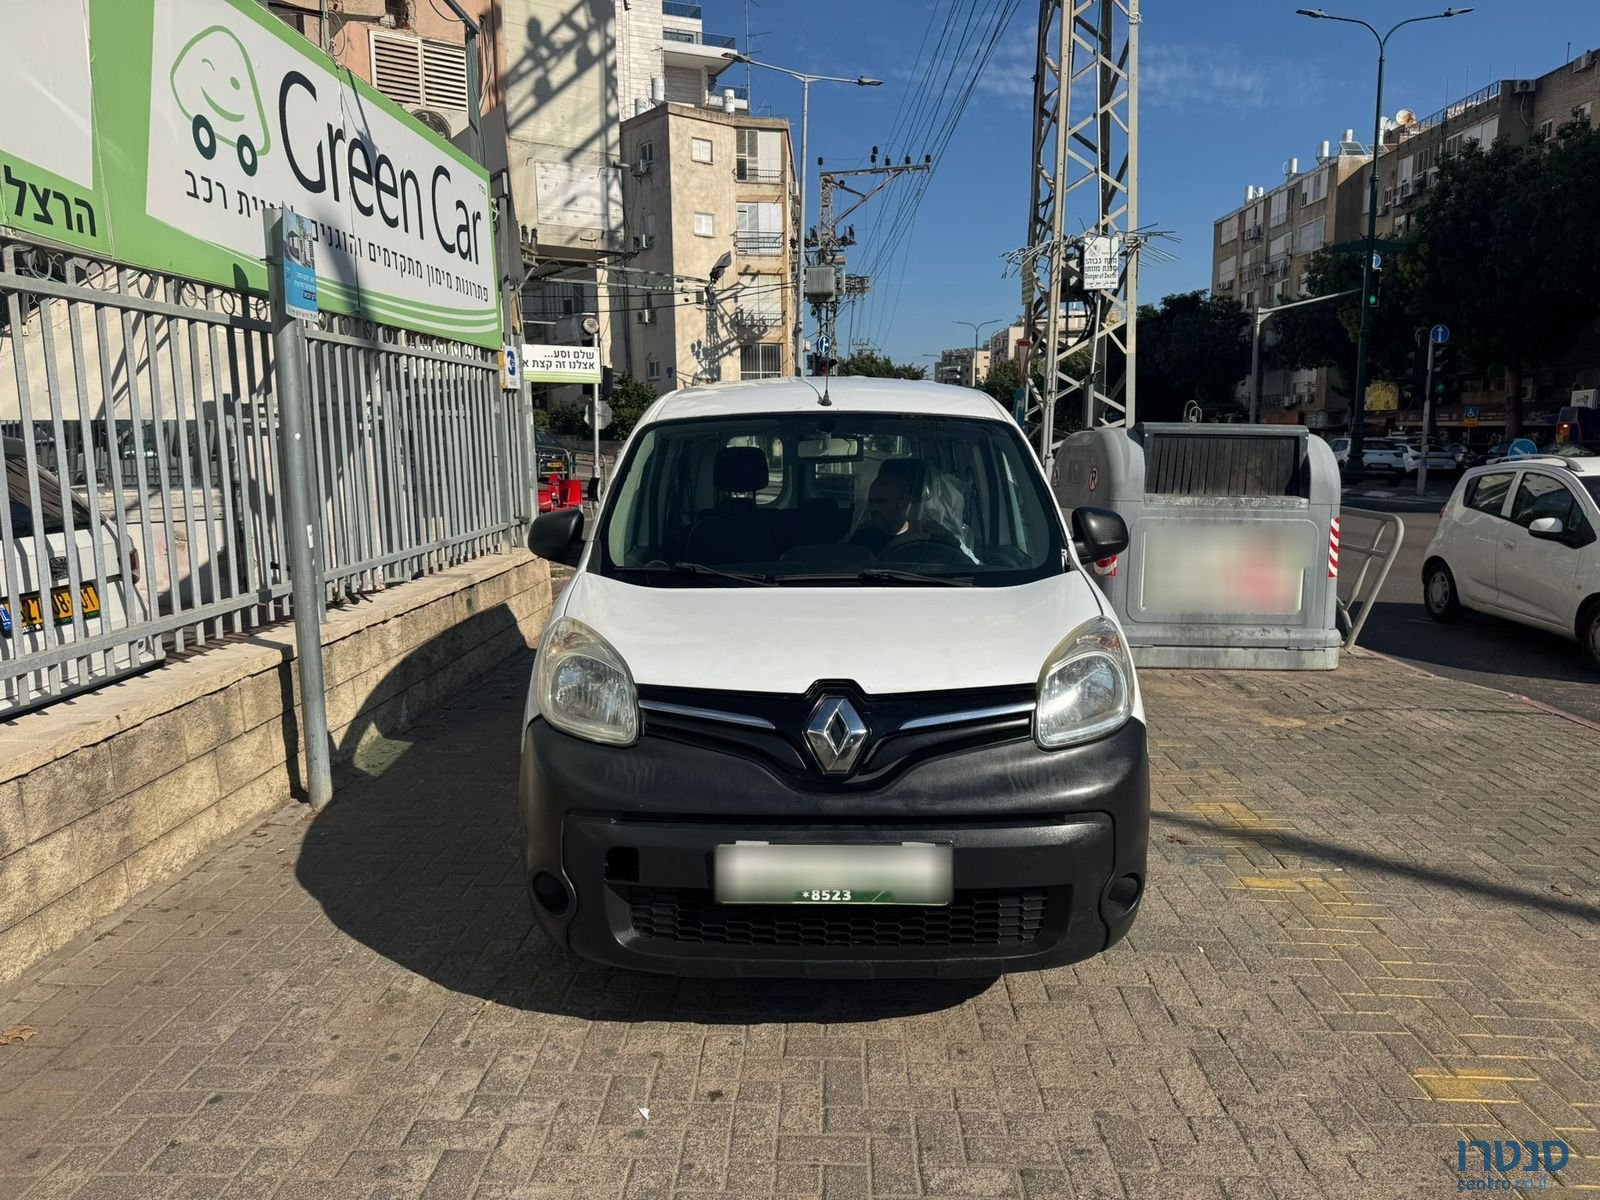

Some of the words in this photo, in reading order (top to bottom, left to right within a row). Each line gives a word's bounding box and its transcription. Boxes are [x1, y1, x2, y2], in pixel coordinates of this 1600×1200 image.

[279, 70, 424, 241] Green
[431, 164, 482, 266] Car
[3, 164, 97, 238] הרצל
[184, 169, 228, 210] רכב
[368, 241, 423, 279] מתקדמים
[426, 263, 453, 289] מימון
[456, 275, 489, 302] פתרונות
[532, 359, 553, 371] קצת
[544, 349, 571, 359] וסע...
[555, 360, 566, 369] זה
[569, 360, 595, 370] אצלנו
[573, 349, 594, 359] שלם
